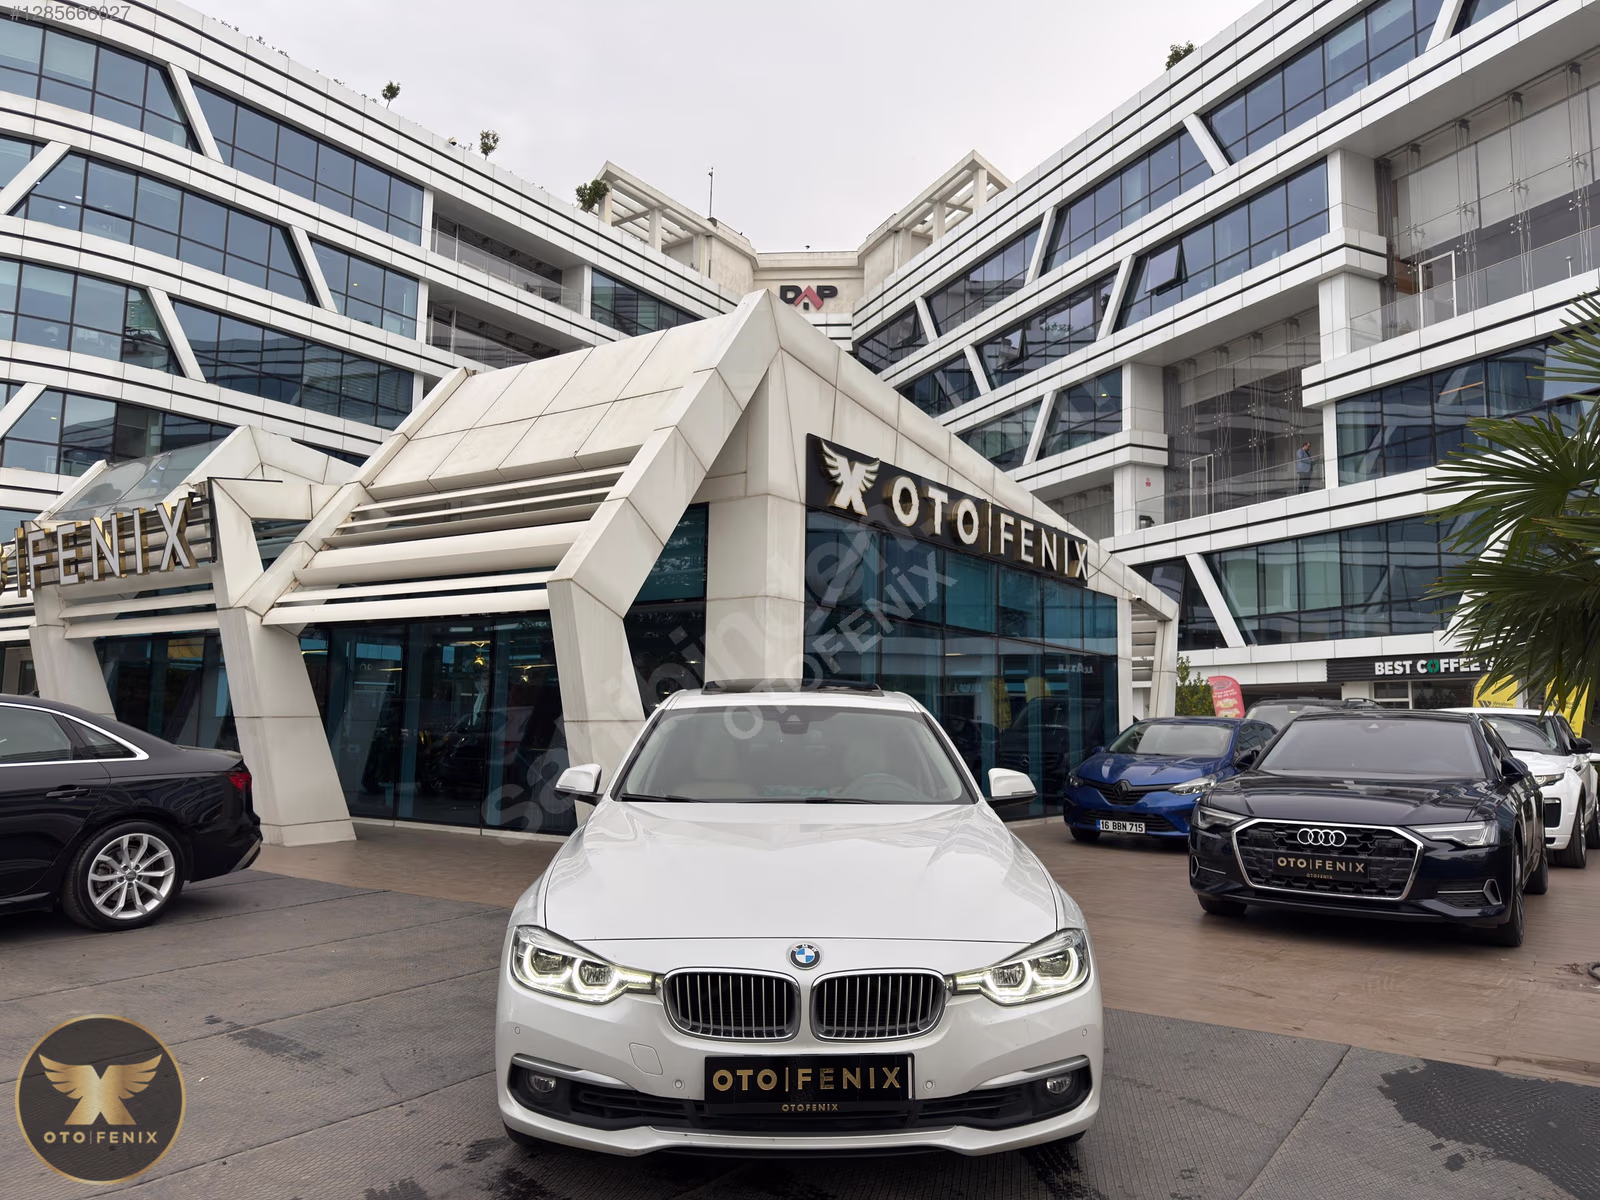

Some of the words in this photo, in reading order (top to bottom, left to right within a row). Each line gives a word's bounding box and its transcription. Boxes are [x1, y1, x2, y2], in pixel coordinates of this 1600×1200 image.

[1374, 660, 1412, 676] BEST
[1416, 657, 1481, 674] COFFEE
[1101, 820, 1110, 830] 16
[1112, 821, 1127, 831] BBN
[1129, 823, 1144, 833] 715
[781, 1103, 839, 1112] OTOFENIX
